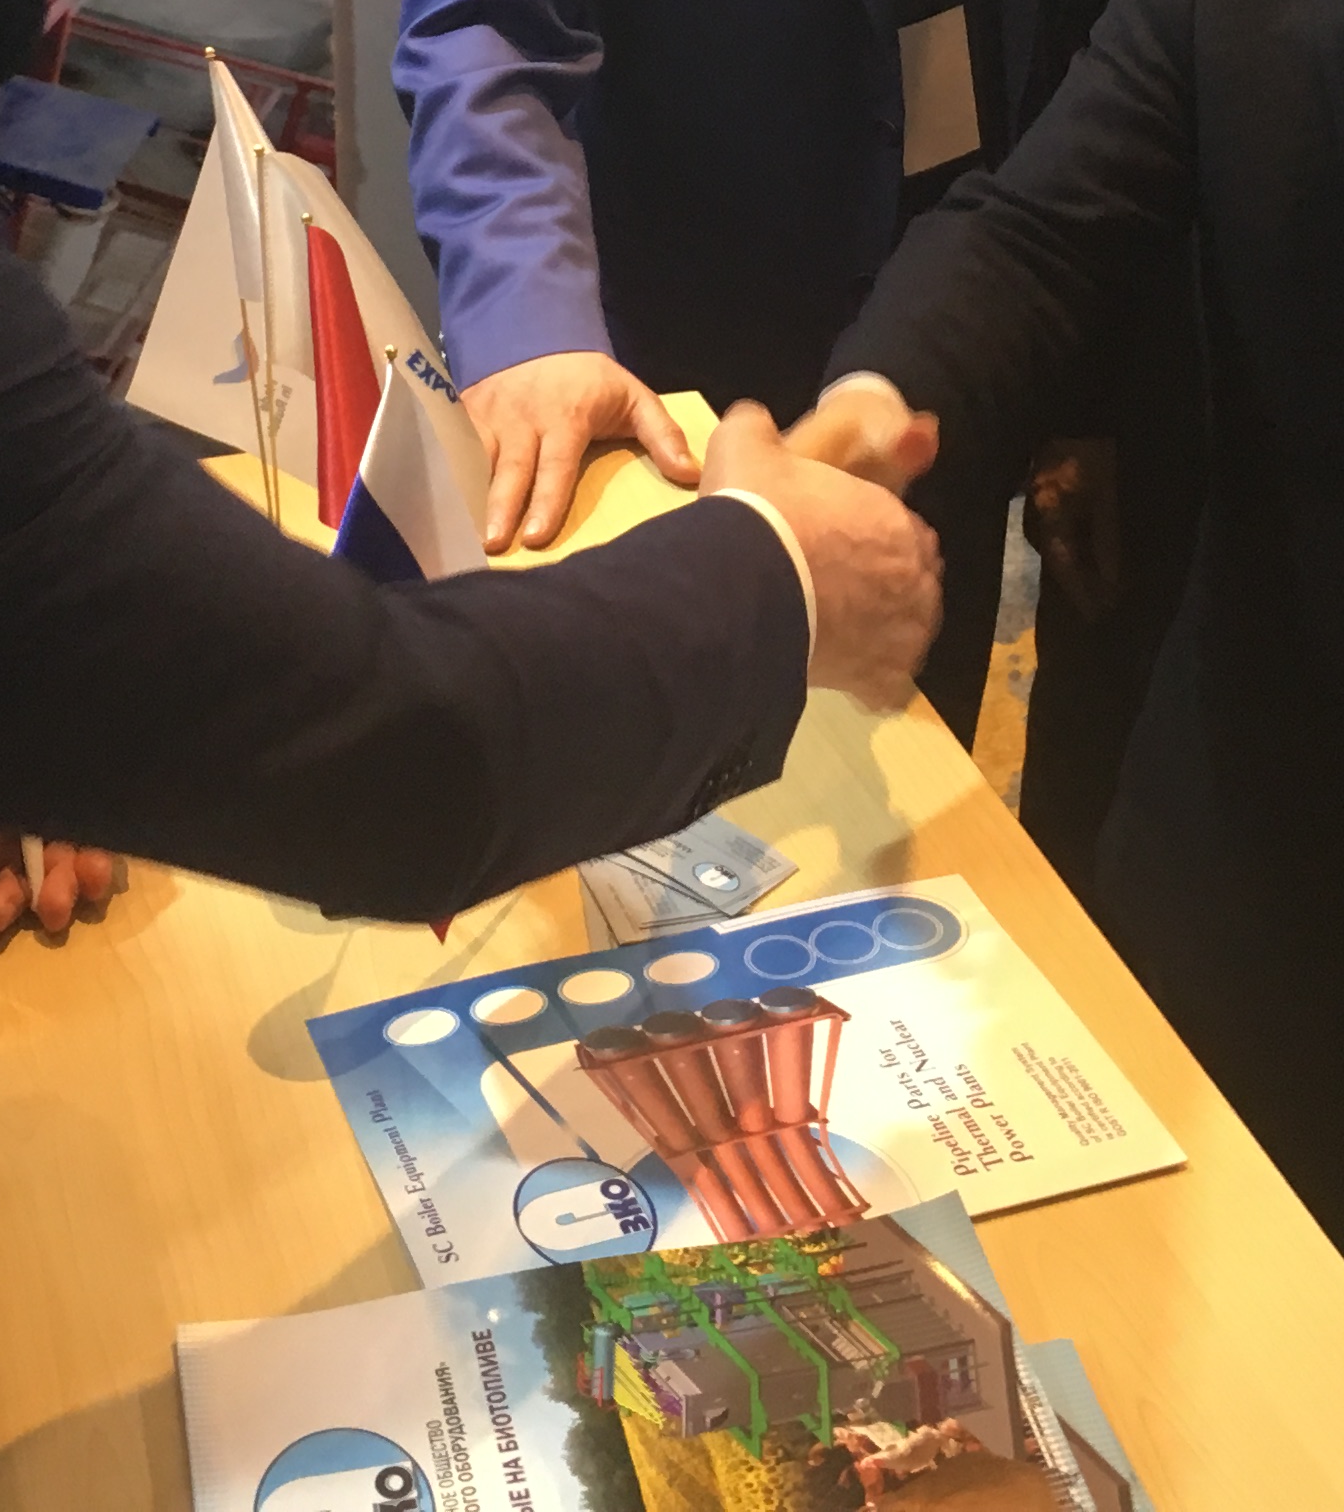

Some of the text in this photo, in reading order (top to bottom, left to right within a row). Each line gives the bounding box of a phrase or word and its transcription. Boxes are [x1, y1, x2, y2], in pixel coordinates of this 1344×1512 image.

[406, 349, 458, 403] EXPO
[879, 1048, 979, 1176] Pipeline Parts for
[890, 1019, 1004, 1171] Thermal and Nuclear
[956, 1063, 1035, 1163] Power Plants
[366, 1088, 460, 1264] SC Boiler Equipment Plant
[471, 1328, 520, 1453] БИОТОПЛИВЕ
[425, 1419, 455, 1489] ОБЩЕСТВО
[502, 1456, 527, 1484] НА
